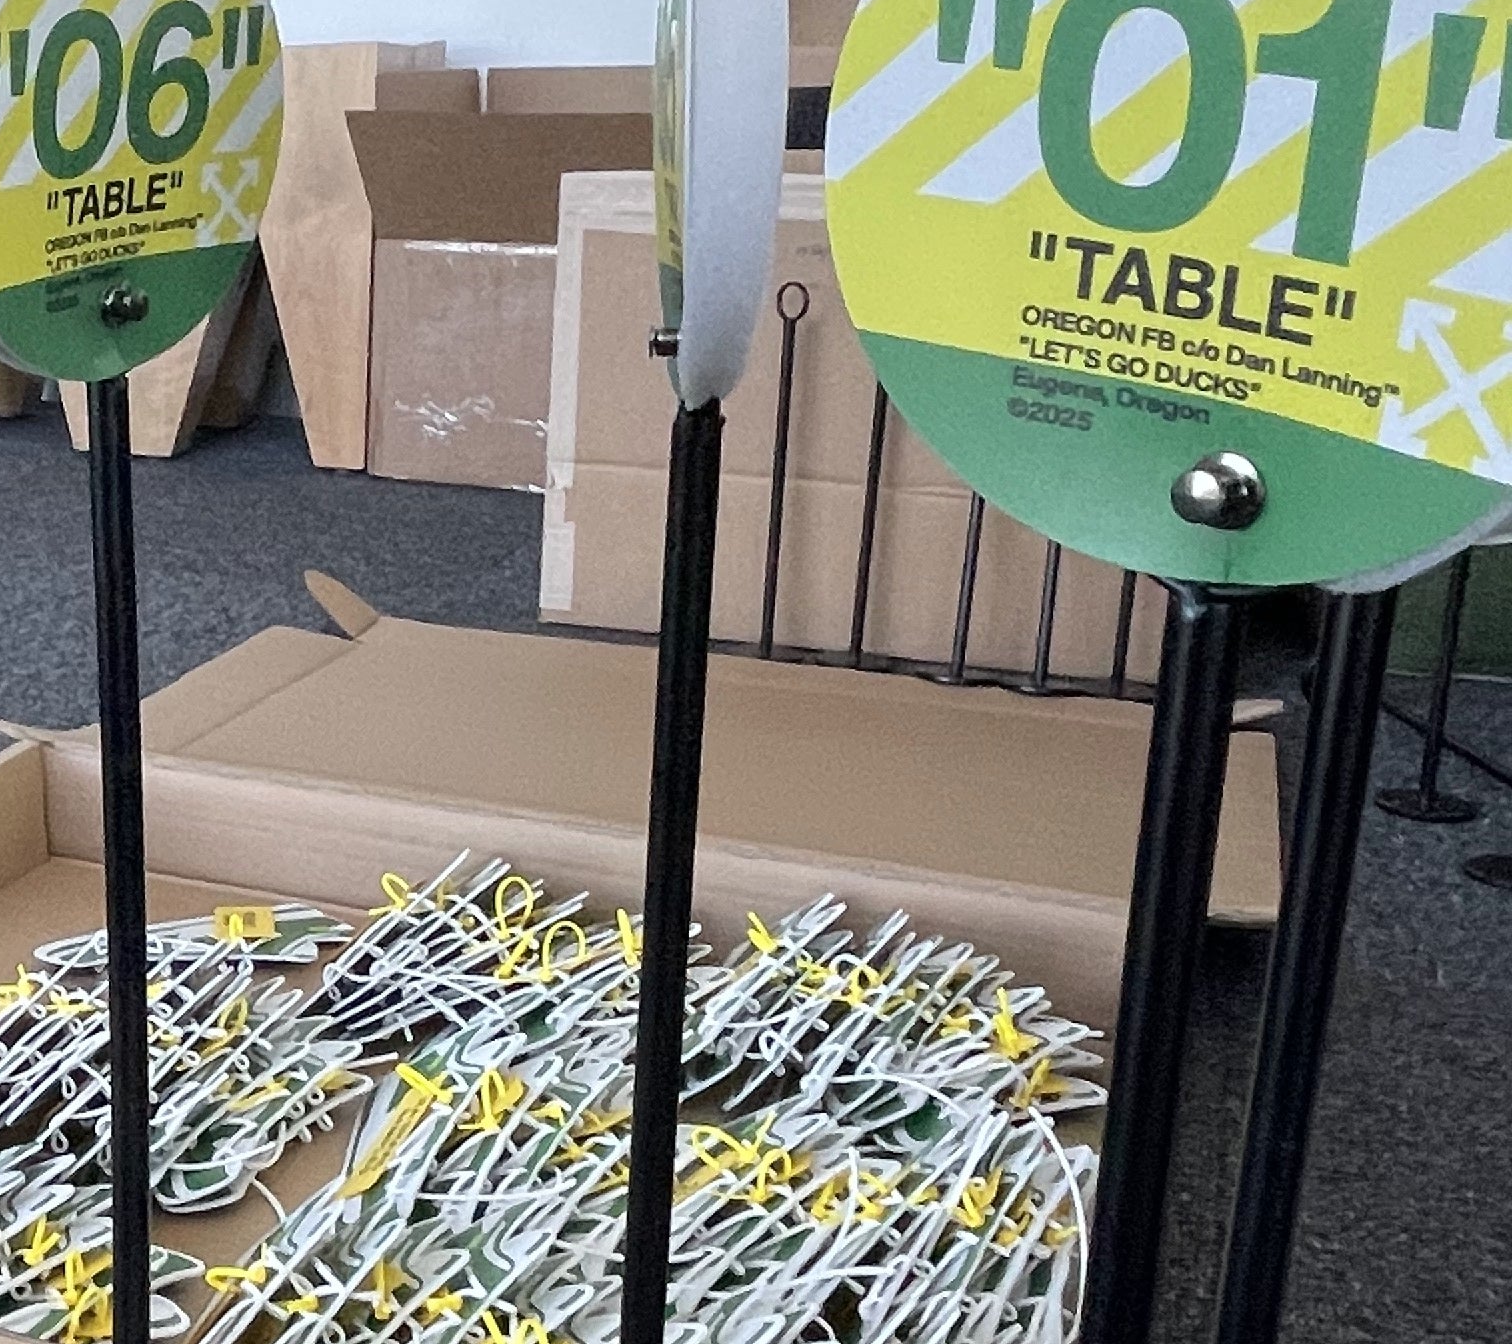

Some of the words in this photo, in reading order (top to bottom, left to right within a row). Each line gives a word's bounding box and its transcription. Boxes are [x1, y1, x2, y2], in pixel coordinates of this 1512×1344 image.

[46, 170, 184, 227] "TABLE"
[1028, 230, 1358, 346] "TABLE"
[1019, 335, 1102, 369] "LET'S
[1107, 351, 1149, 378] GO
[1154, 361, 1262, 402] DUCKS"
[1021, 304, 1136, 345] OREGON
[1141, 326, 1176, 352] FB
[1181, 337, 1220, 362] c/o
[1226, 344, 1275, 376] Dan
[1006, 396, 1094, 433] ©2025
[1115, 385, 1211, 426] Oregon
